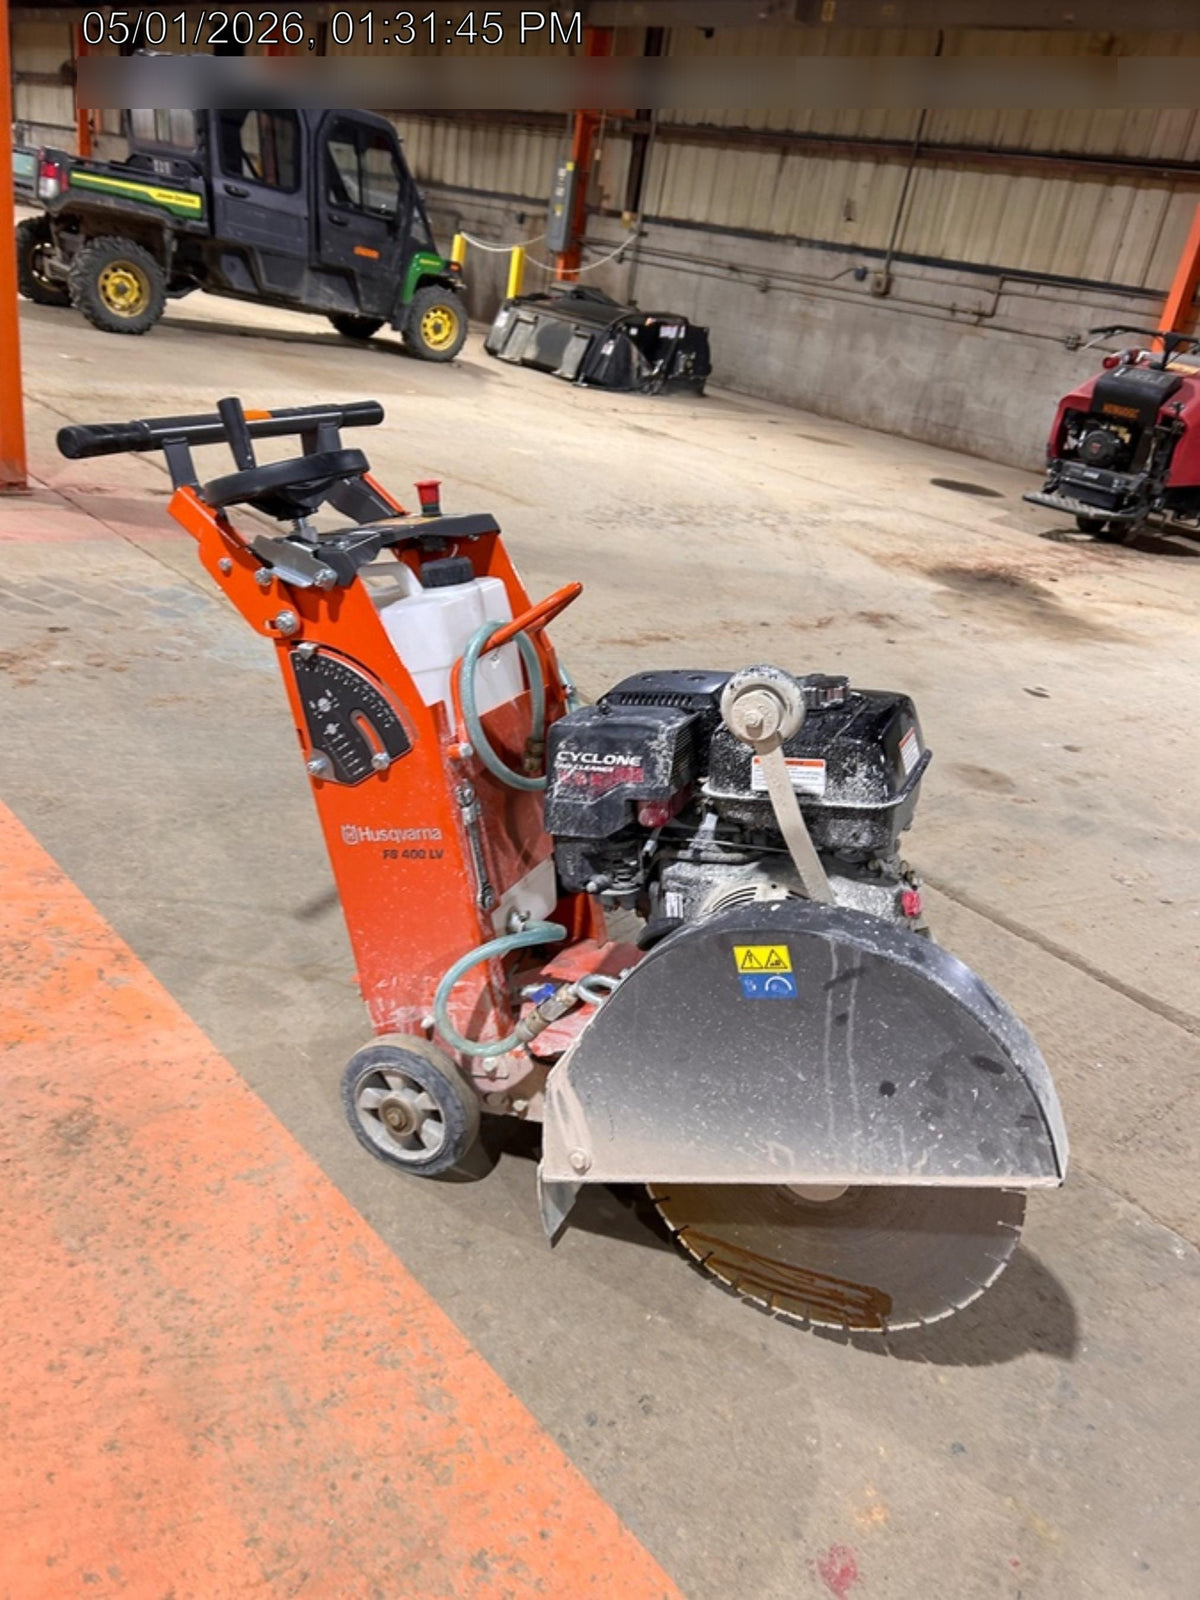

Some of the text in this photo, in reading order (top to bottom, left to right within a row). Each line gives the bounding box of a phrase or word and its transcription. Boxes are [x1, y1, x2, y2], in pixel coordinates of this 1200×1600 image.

[556, 751, 642, 766] CYCLONE
[359, 826, 443, 843] Husqvarna
[401, 849, 427, 860] 400
[429, 849, 444, 860] LV
